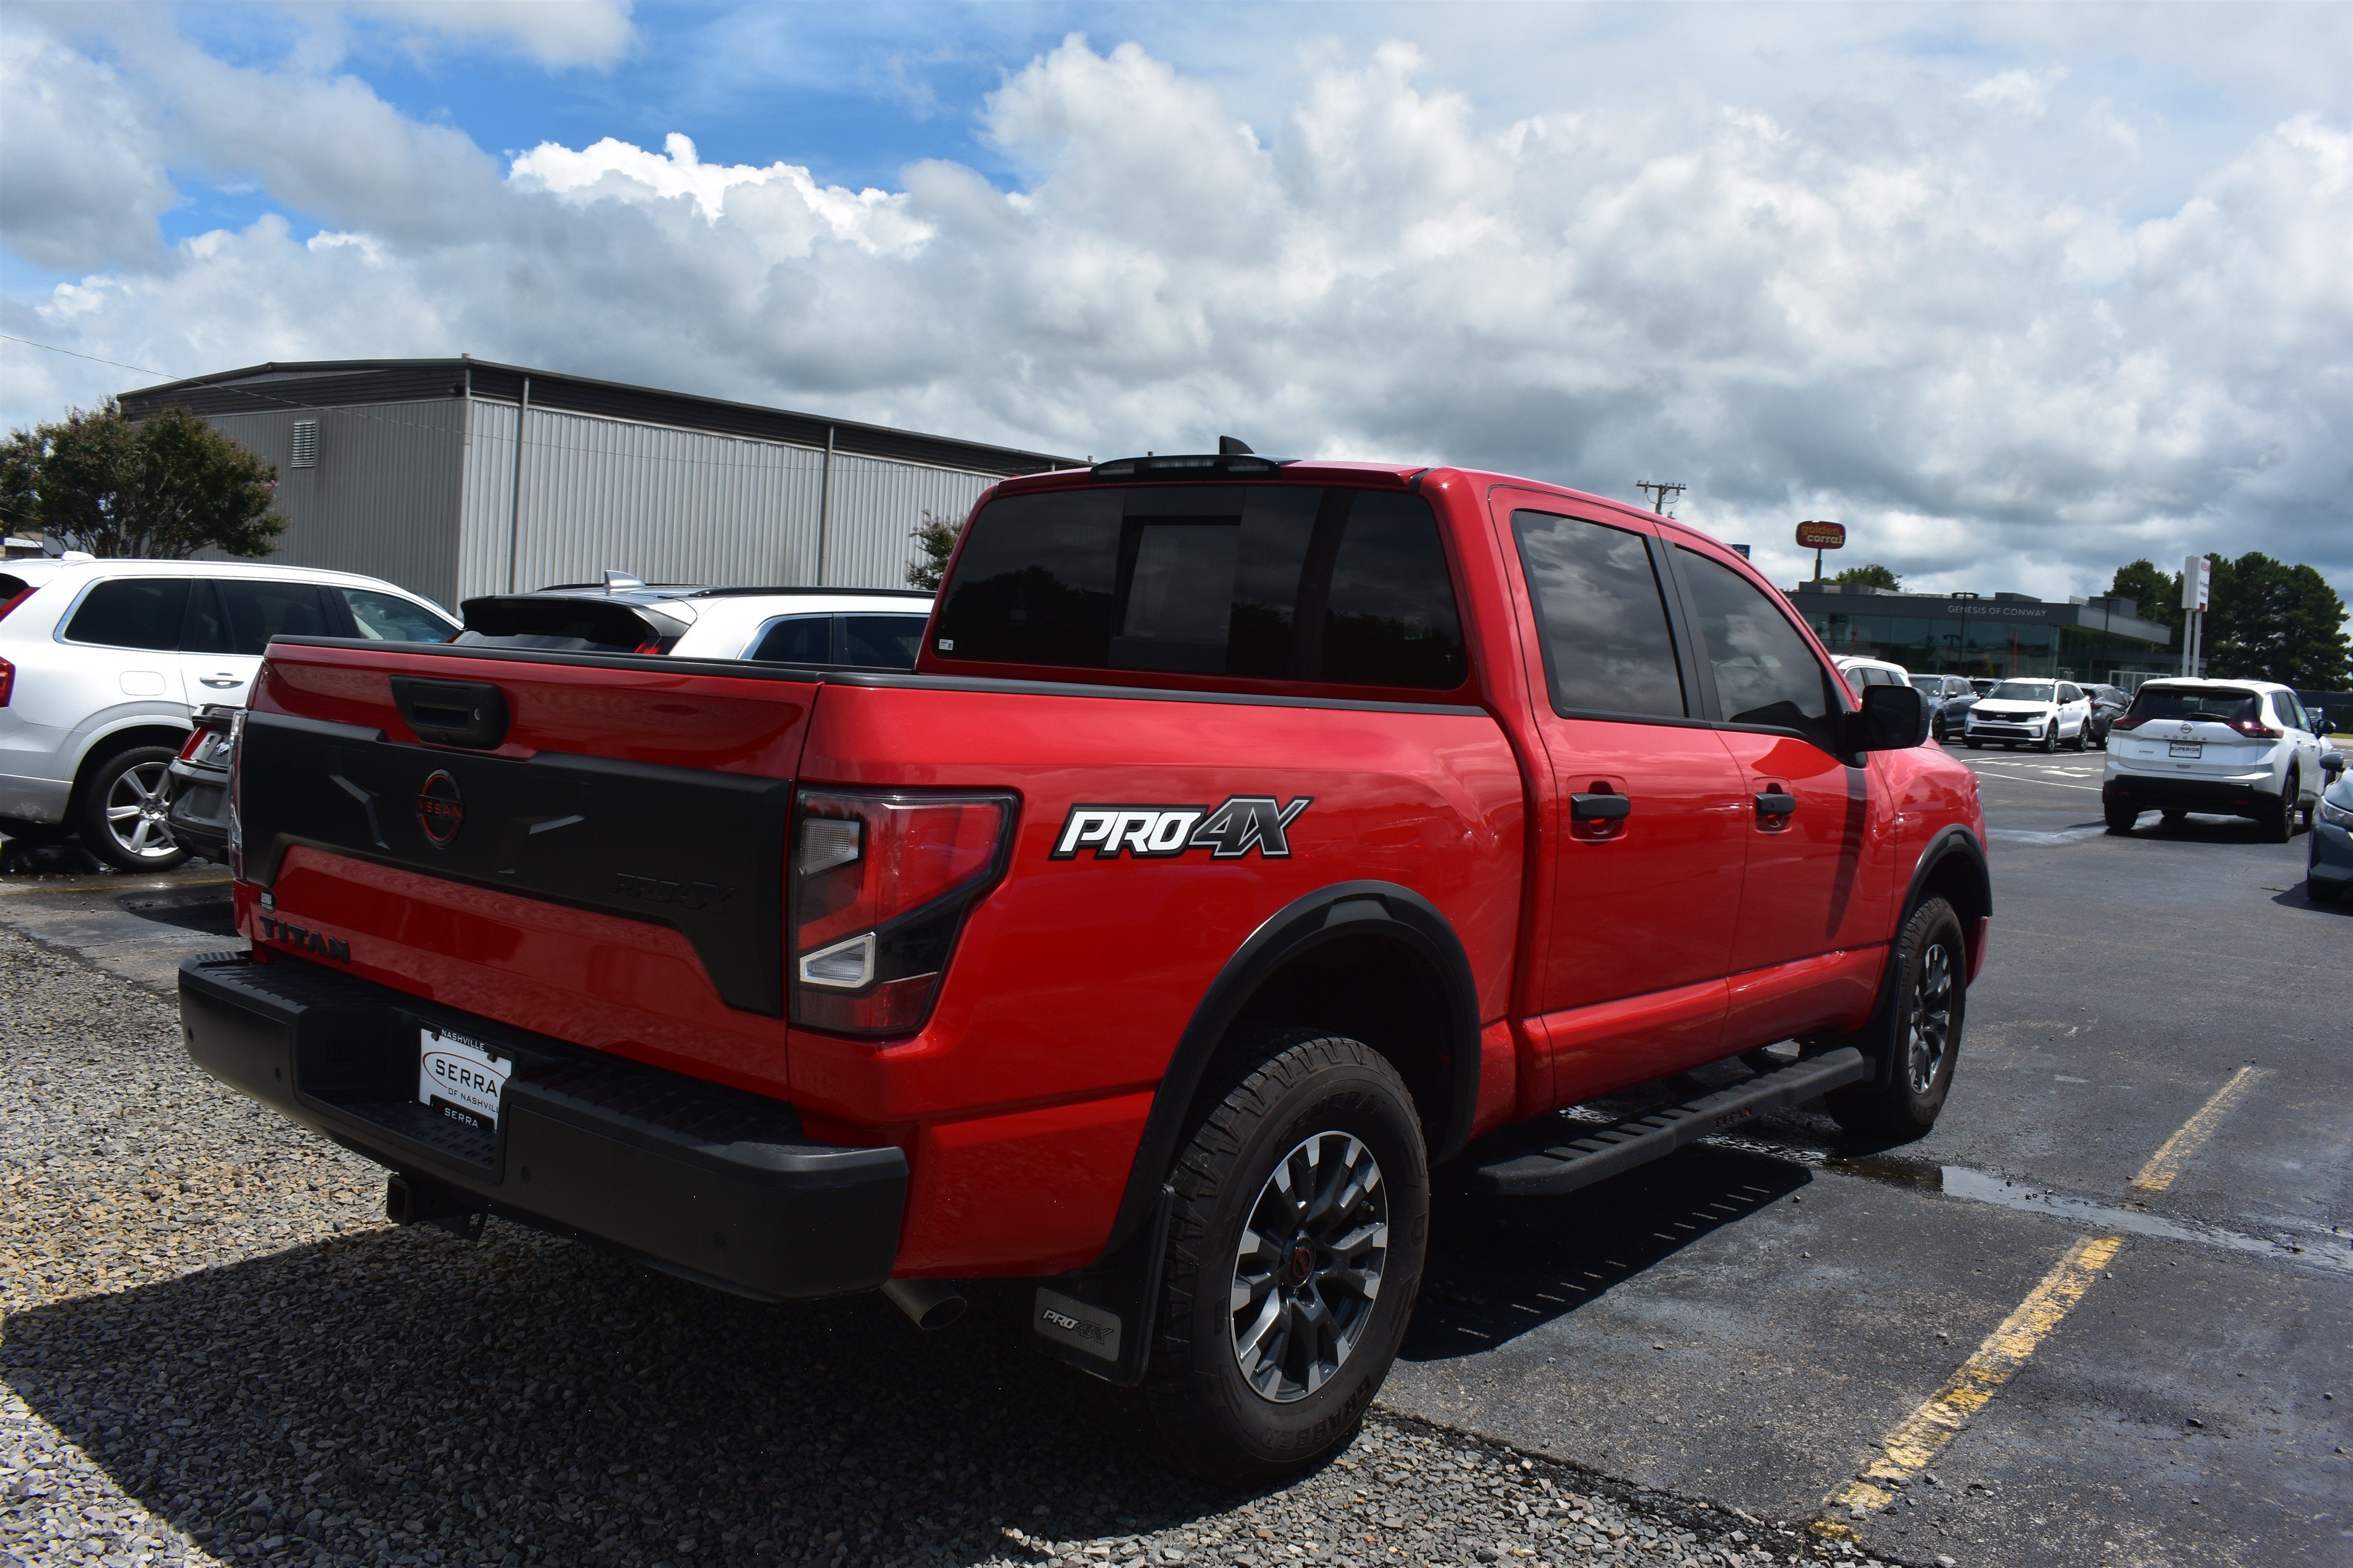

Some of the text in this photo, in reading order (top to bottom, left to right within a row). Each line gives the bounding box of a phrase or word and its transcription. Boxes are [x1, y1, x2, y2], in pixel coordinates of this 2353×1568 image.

[1802, 525, 1839, 535] golden
[1807, 535, 1843, 544] corral
[1947, 605, 1986, 614] GENESIS
[2004, 608, 2047, 616] CONWAY
[418, 799, 462, 818] NISSAN
[260, 914, 350, 964] TITAN
[441, 1029, 485, 1051] NASHVILLE
[435, 1059, 498, 1098] SERRA
[448, 1087, 499, 1114] OF NASHVILL
[444, 1107, 479, 1129] SERRA
[1261, 1373, 1371, 1451] GRABBER
